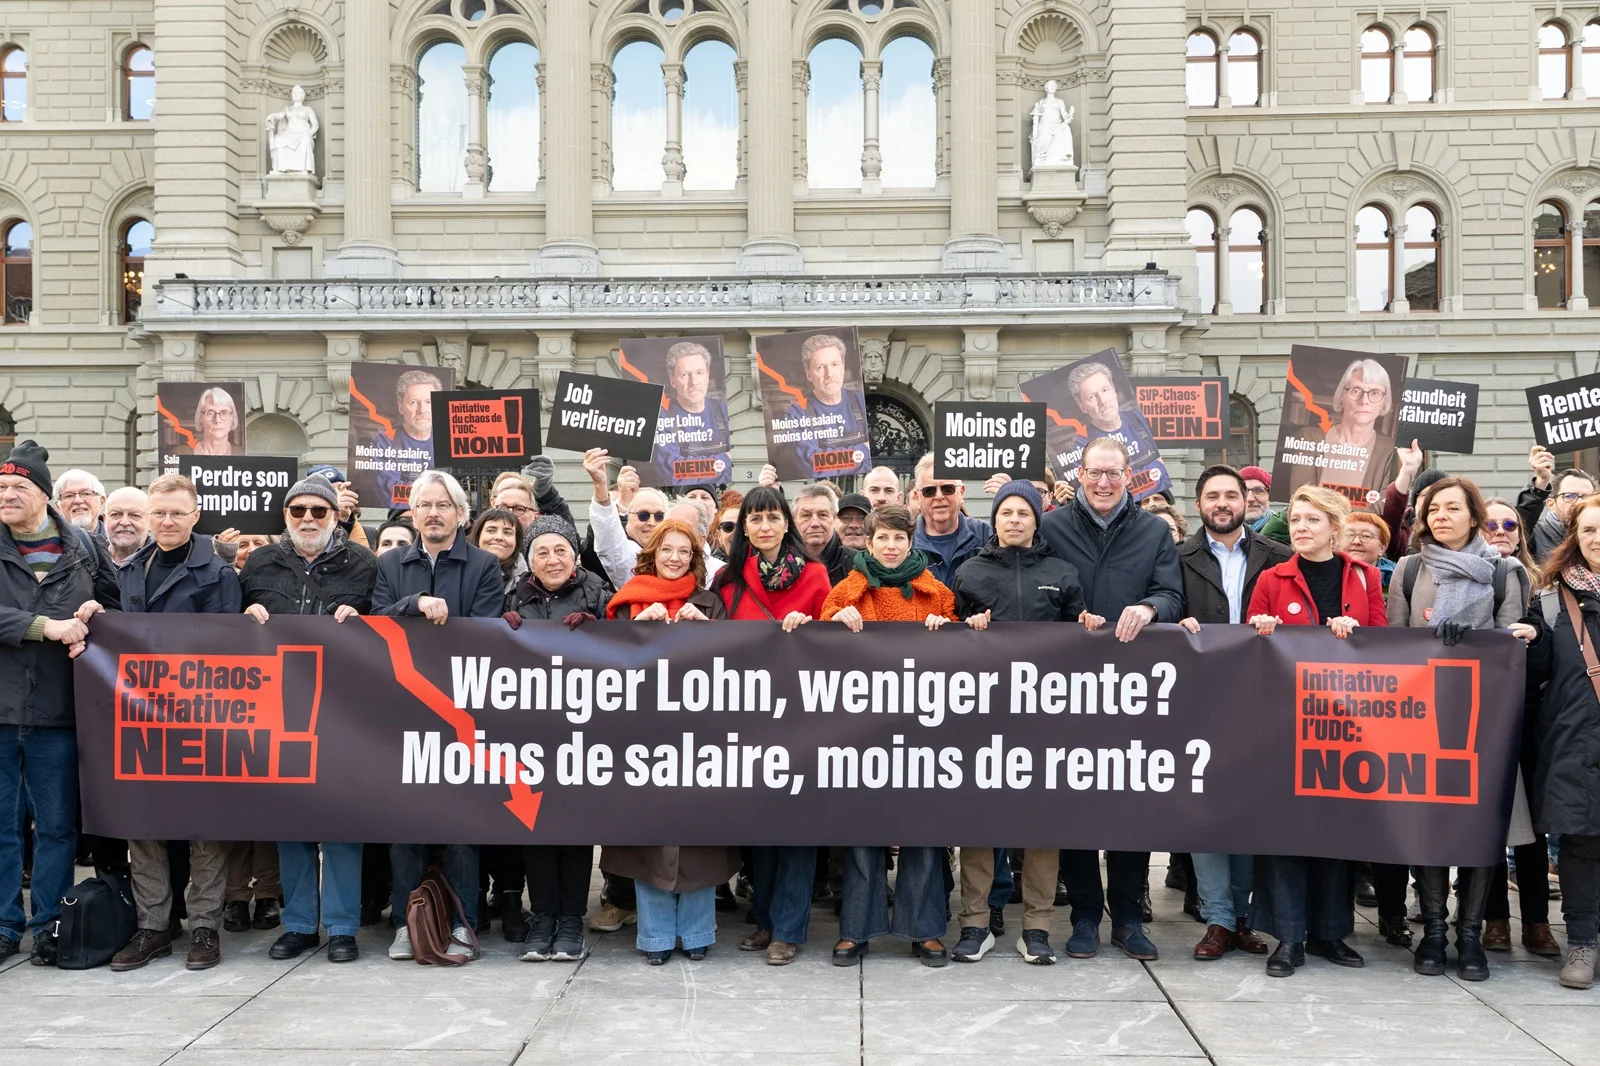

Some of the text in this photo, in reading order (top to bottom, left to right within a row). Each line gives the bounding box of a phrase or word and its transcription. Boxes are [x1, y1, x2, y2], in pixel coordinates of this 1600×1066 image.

[564, 383, 592, 404] Job
[1140, 388, 1200, 401] SVP-Chaos-
[1402, 389, 1466, 408] sundheit
[452, 403, 490, 413] Initiative
[452, 411, 502, 424] du chaos de
[1140, 402, 1195, 415] Initiative:
[1399, 405, 1464, 427] fährden?
[561, 410, 646, 437] verlieren?
[676, 414, 705, 428] Lohn,
[772, 413, 846, 430] Moins de salaire,
[946, 412, 1035, 438] Moins de
[678, 429, 713, 442] Rente?
[773, 430, 801, 444] moins
[802, 429, 813, 440] de
[814, 428, 838, 440] rente
[356, 445, 431, 461] Moins de salaire,
[944, 443, 1015, 468] salaire
[1284, 436, 1369, 459] Moins de salaire,
[164, 454, 180, 464] Sala
[355, 459, 384, 471] moins
[385, 459, 396, 471] de
[398, 461, 422, 472] rente
[1282, 453, 1314, 466] moins
[1315, 455, 1327, 467] de
[1329, 459, 1358, 471] rente
[191, 466, 288, 487] Perdre son
[747, 471, 752, 479] 3
[124, 660, 271, 690] SVP-Chaos-
[1302, 669, 1398, 693] Initiative
[450, 655, 1178, 727] Weniger Lohn, weniger Rente?
[121, 692, 255, 724] Initiative:
[1302, 693, 1426, 719] du chaos de
[402, 729, 544, 785] Moins
[556, 732, 613, 786] de
[624, 732, 804, 795] salaire,
[817, 734, 964, 789] moins
[975, 734, 1033, 789] de
[1045, 739, 1176, 793] rente
